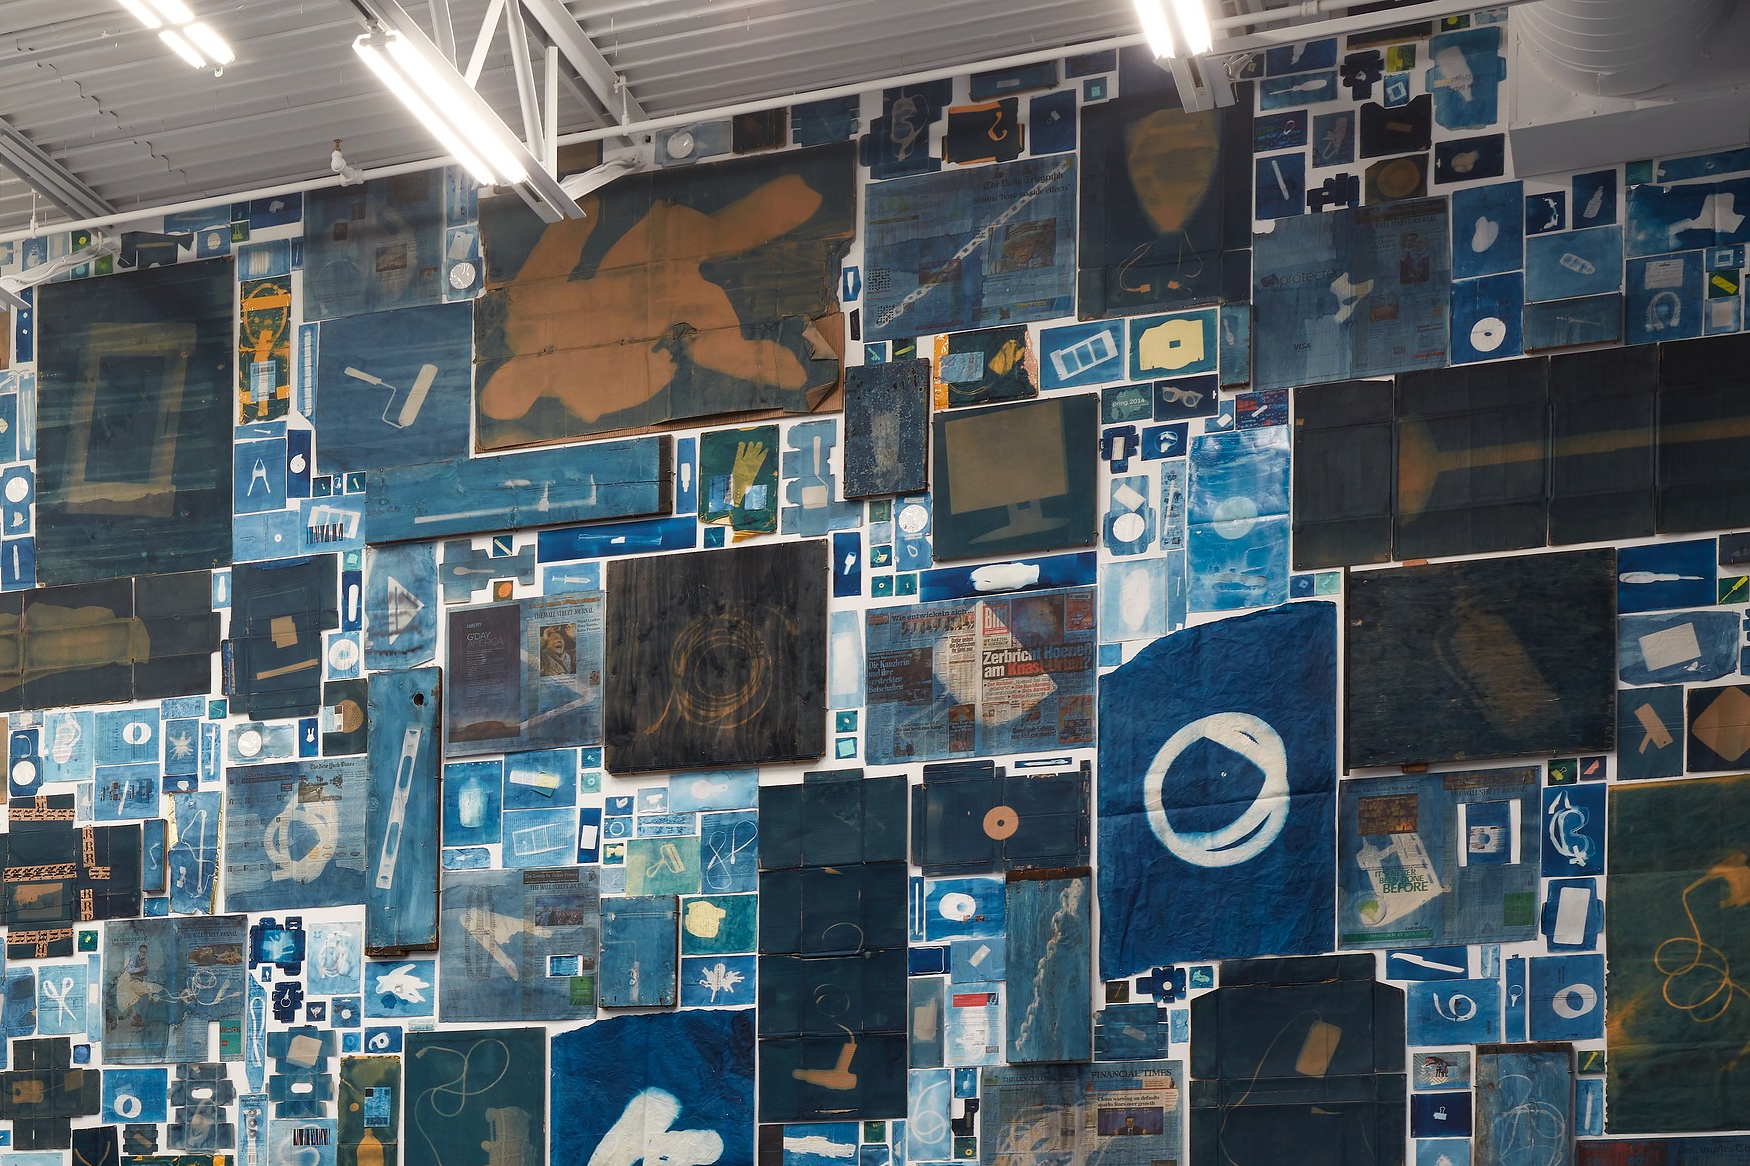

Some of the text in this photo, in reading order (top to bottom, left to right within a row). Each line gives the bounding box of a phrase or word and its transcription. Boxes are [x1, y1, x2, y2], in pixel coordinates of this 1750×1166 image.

[985, 171, 1064, 190] The Daily Telegraph
[1029, 188, 1044, 197] side
[1129, 397, 1145, 405] 2014
[544, 610, 556, 618] WALL
[556, 609, 573, 617] STREET
[574, 607, 594, 616] JOURNAL
[892, 610, 950, 622] Wie entwickeln
[466, 631, 492, 641] G'DAY
[466, 637, 505, 648] AMERICA
[983, 642, 1093, 666] Zerbricht Hoeneß
[869, 659, 910, 669] Die Kanzlerin
[881, 668, 894, 676] ihre
[984, 665, 1005, 678] am
[869, 676, 903, 686] versteckten
[869, 684, 904, 693] Botschaften
[1374, 868, 1417, 879] IT'S NEVER
[1379, 875, 1424, 884] BEEN DONE
[1382, 880, 1429, 894] BEFORE
[1092, 1068, 1173, 1079] FINANCIAL TIMES
